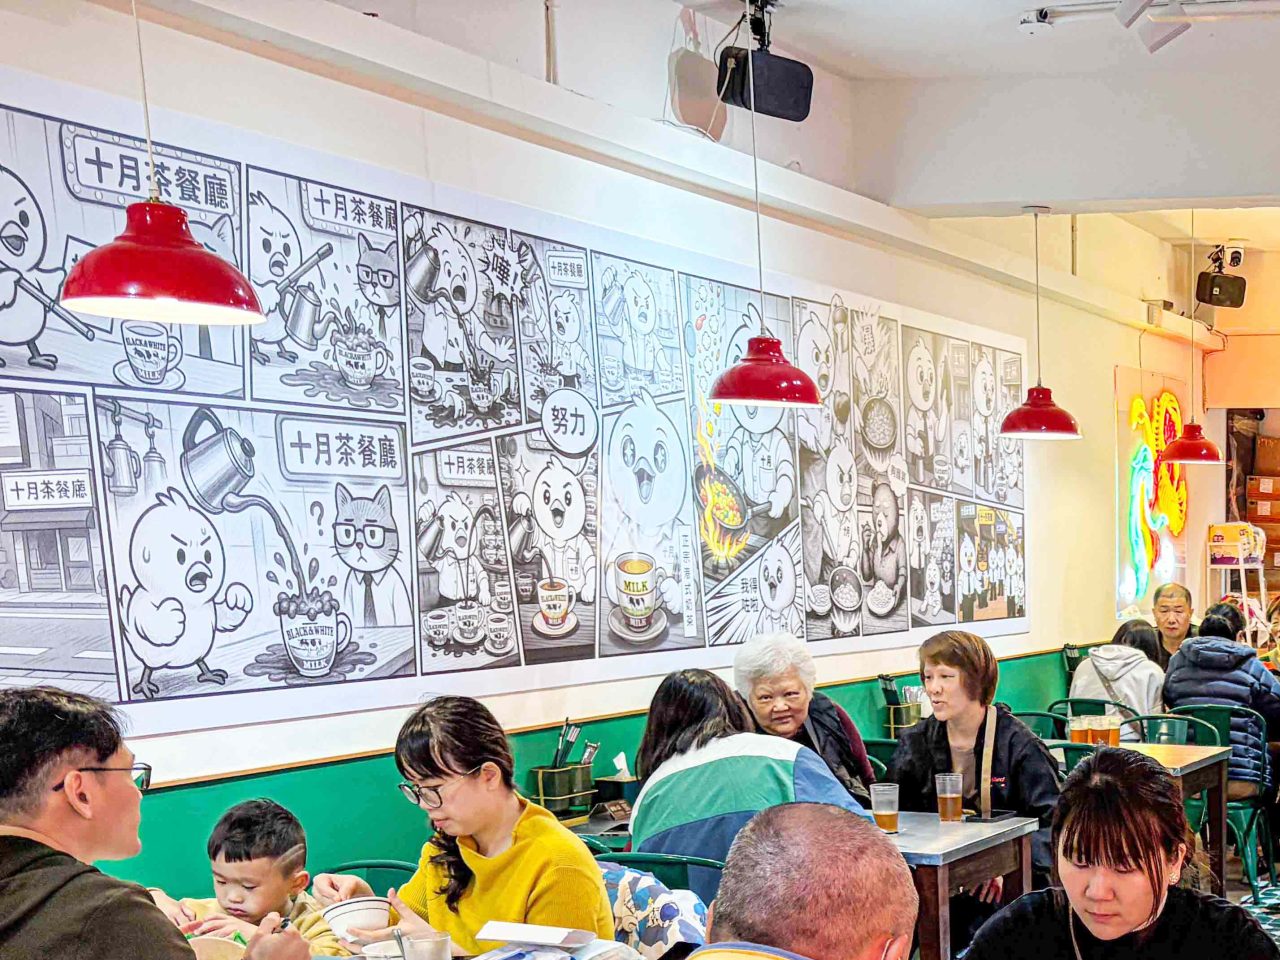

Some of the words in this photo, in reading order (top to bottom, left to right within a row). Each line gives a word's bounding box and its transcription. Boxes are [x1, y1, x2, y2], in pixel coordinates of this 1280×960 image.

[84, 146, 229, 210] 十月茶餐廳
[550, 404, 585, 436] 努力
[290, 430, 398, 470] 十月茶餐廳
[10, 479, 88, 501] 十月茶餐廳
[623, 580, 648, 593] MILK
[286, 625, 334, 641] BLACK&WHITE
[302, 659, 329, 670] MILK
